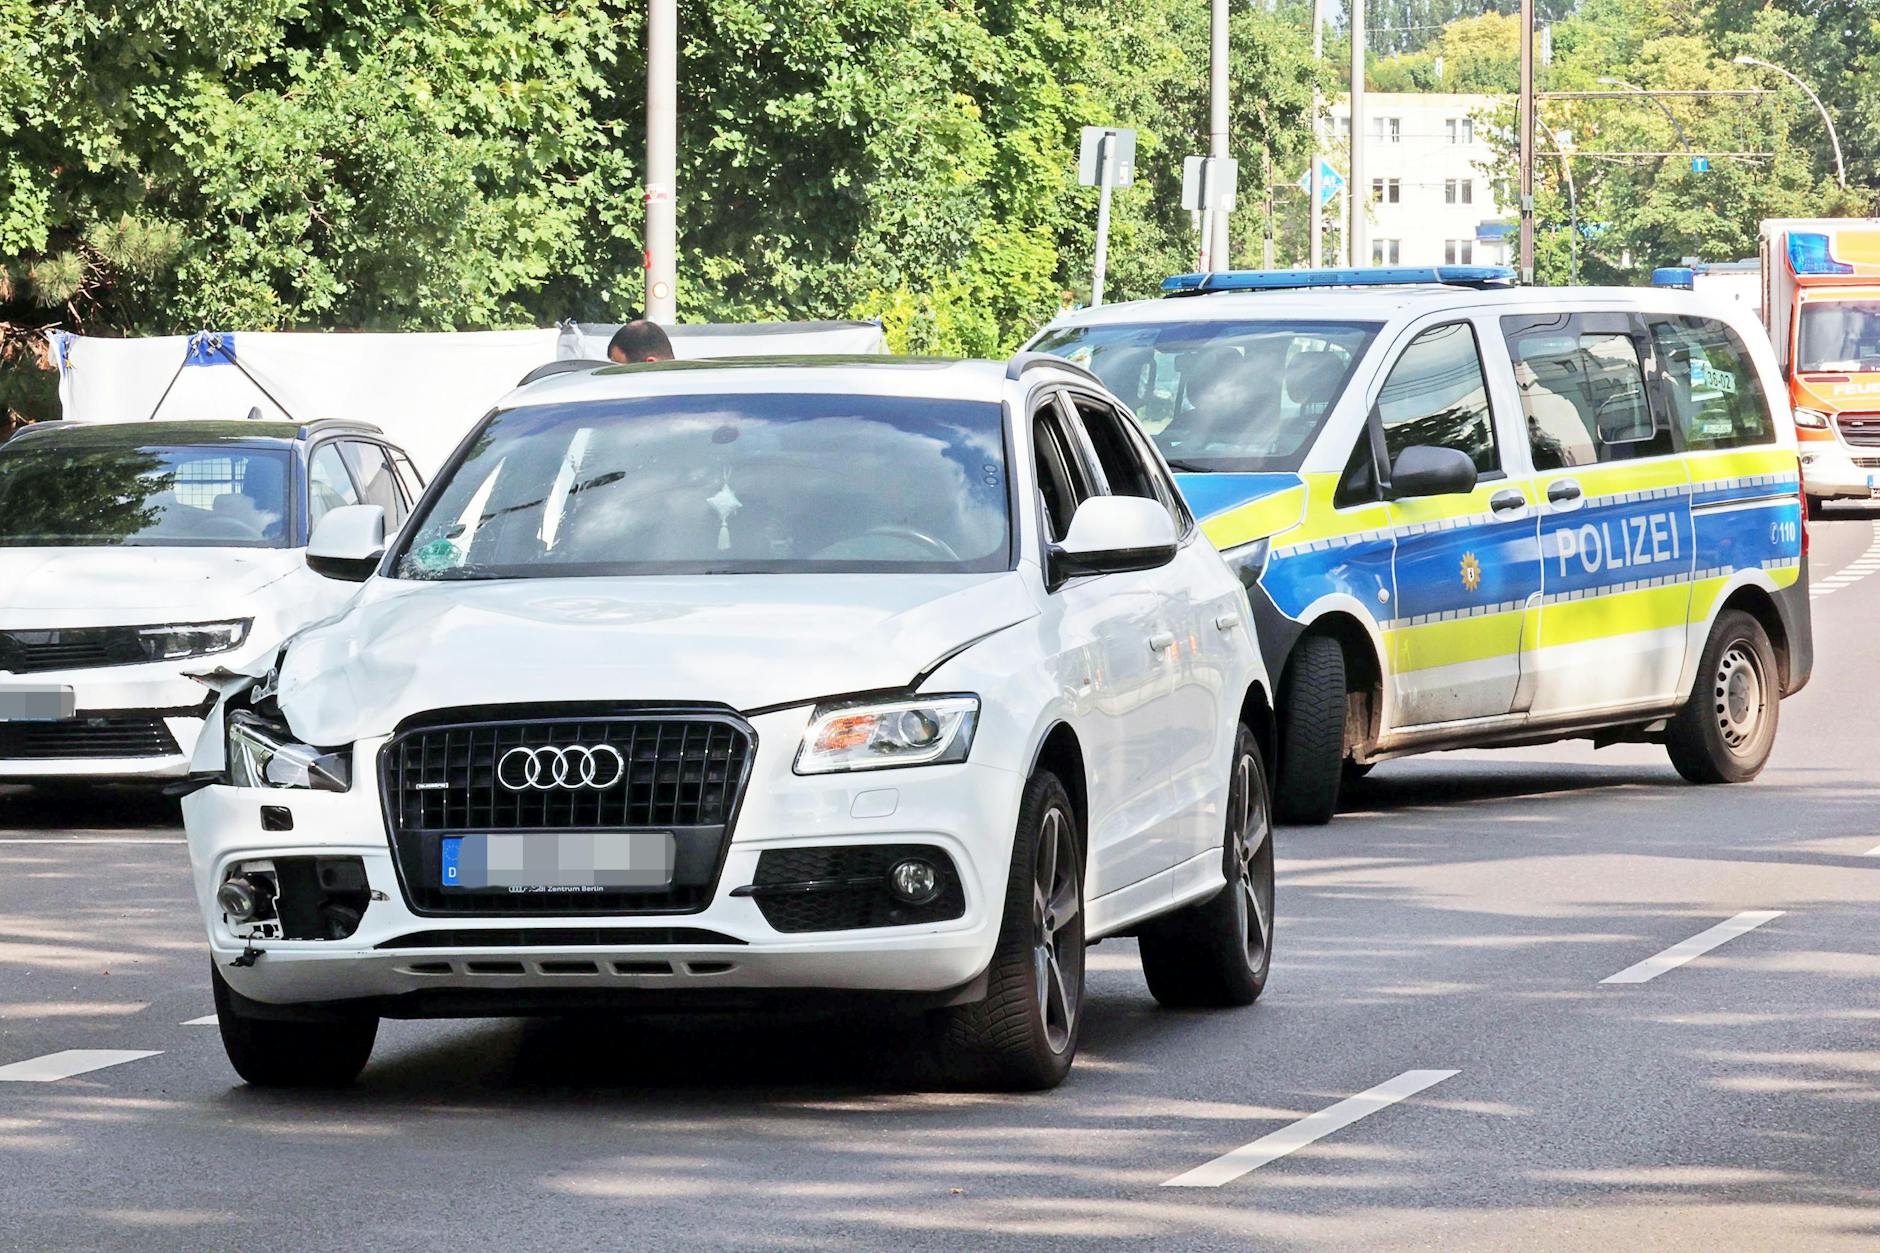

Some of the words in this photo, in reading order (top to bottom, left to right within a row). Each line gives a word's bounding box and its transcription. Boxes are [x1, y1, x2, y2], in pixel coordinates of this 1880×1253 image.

[1780, 521, 1796, 542] 110
[1556, 511, 1680, 577] POLIZEI
[448, 867, 457, 878] D
[581, 885, 604, 893] Berlin
